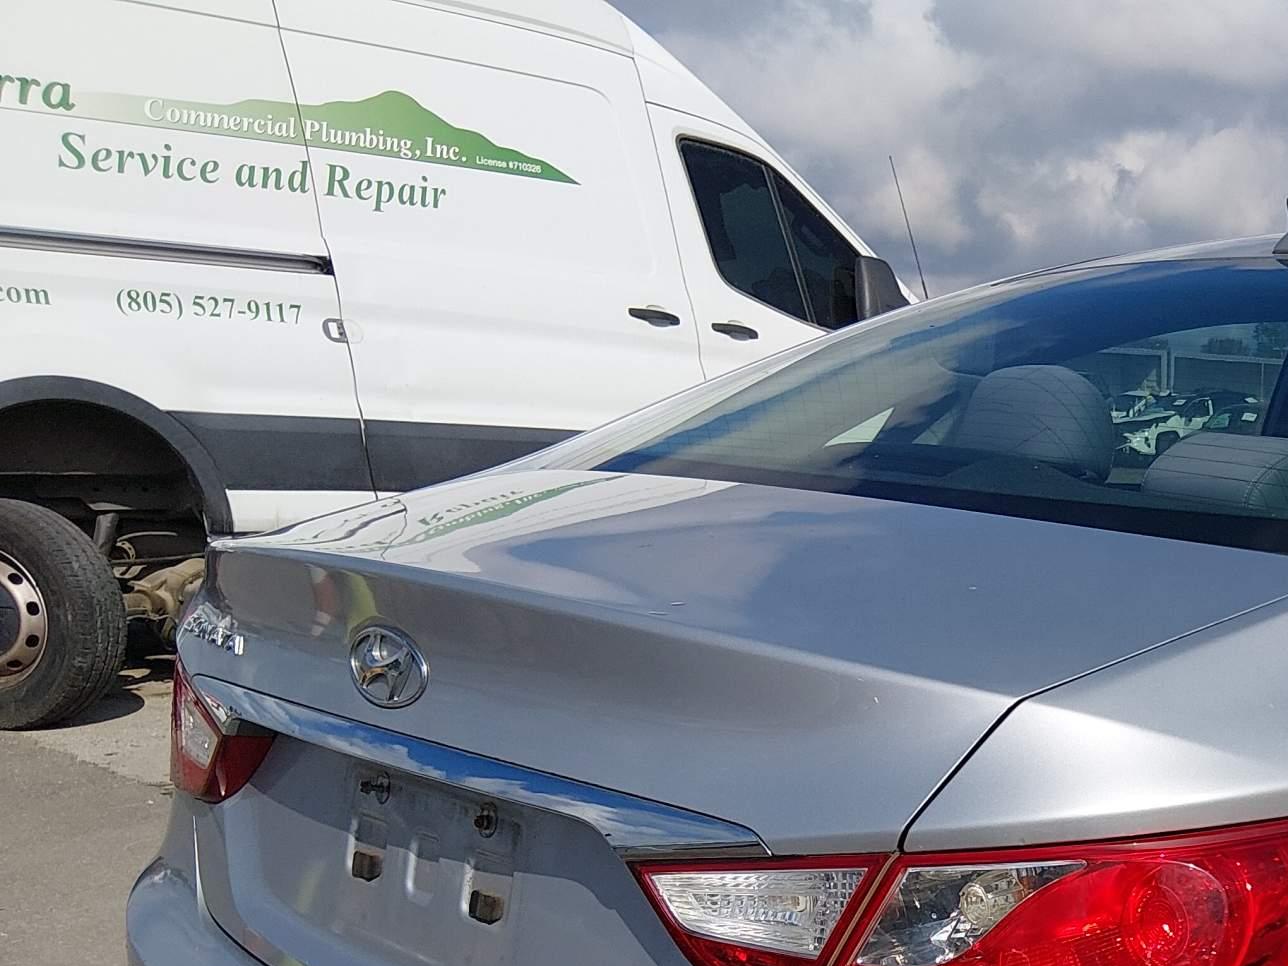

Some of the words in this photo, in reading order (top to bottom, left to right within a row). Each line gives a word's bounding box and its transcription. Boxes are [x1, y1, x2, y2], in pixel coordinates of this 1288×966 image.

[144, 99, 297, 138] Commercial
[303, 119, 421, 160] Plumbing,
[424, 136, 467, 162] Inc.
[58, 132, 221, 184] Service
[235, 160, 310, 194] and
[324, 163, 447, 212] Repair
[116, 288, 184, 320] (805)
[192, 295, 302, 325] 527-9117
